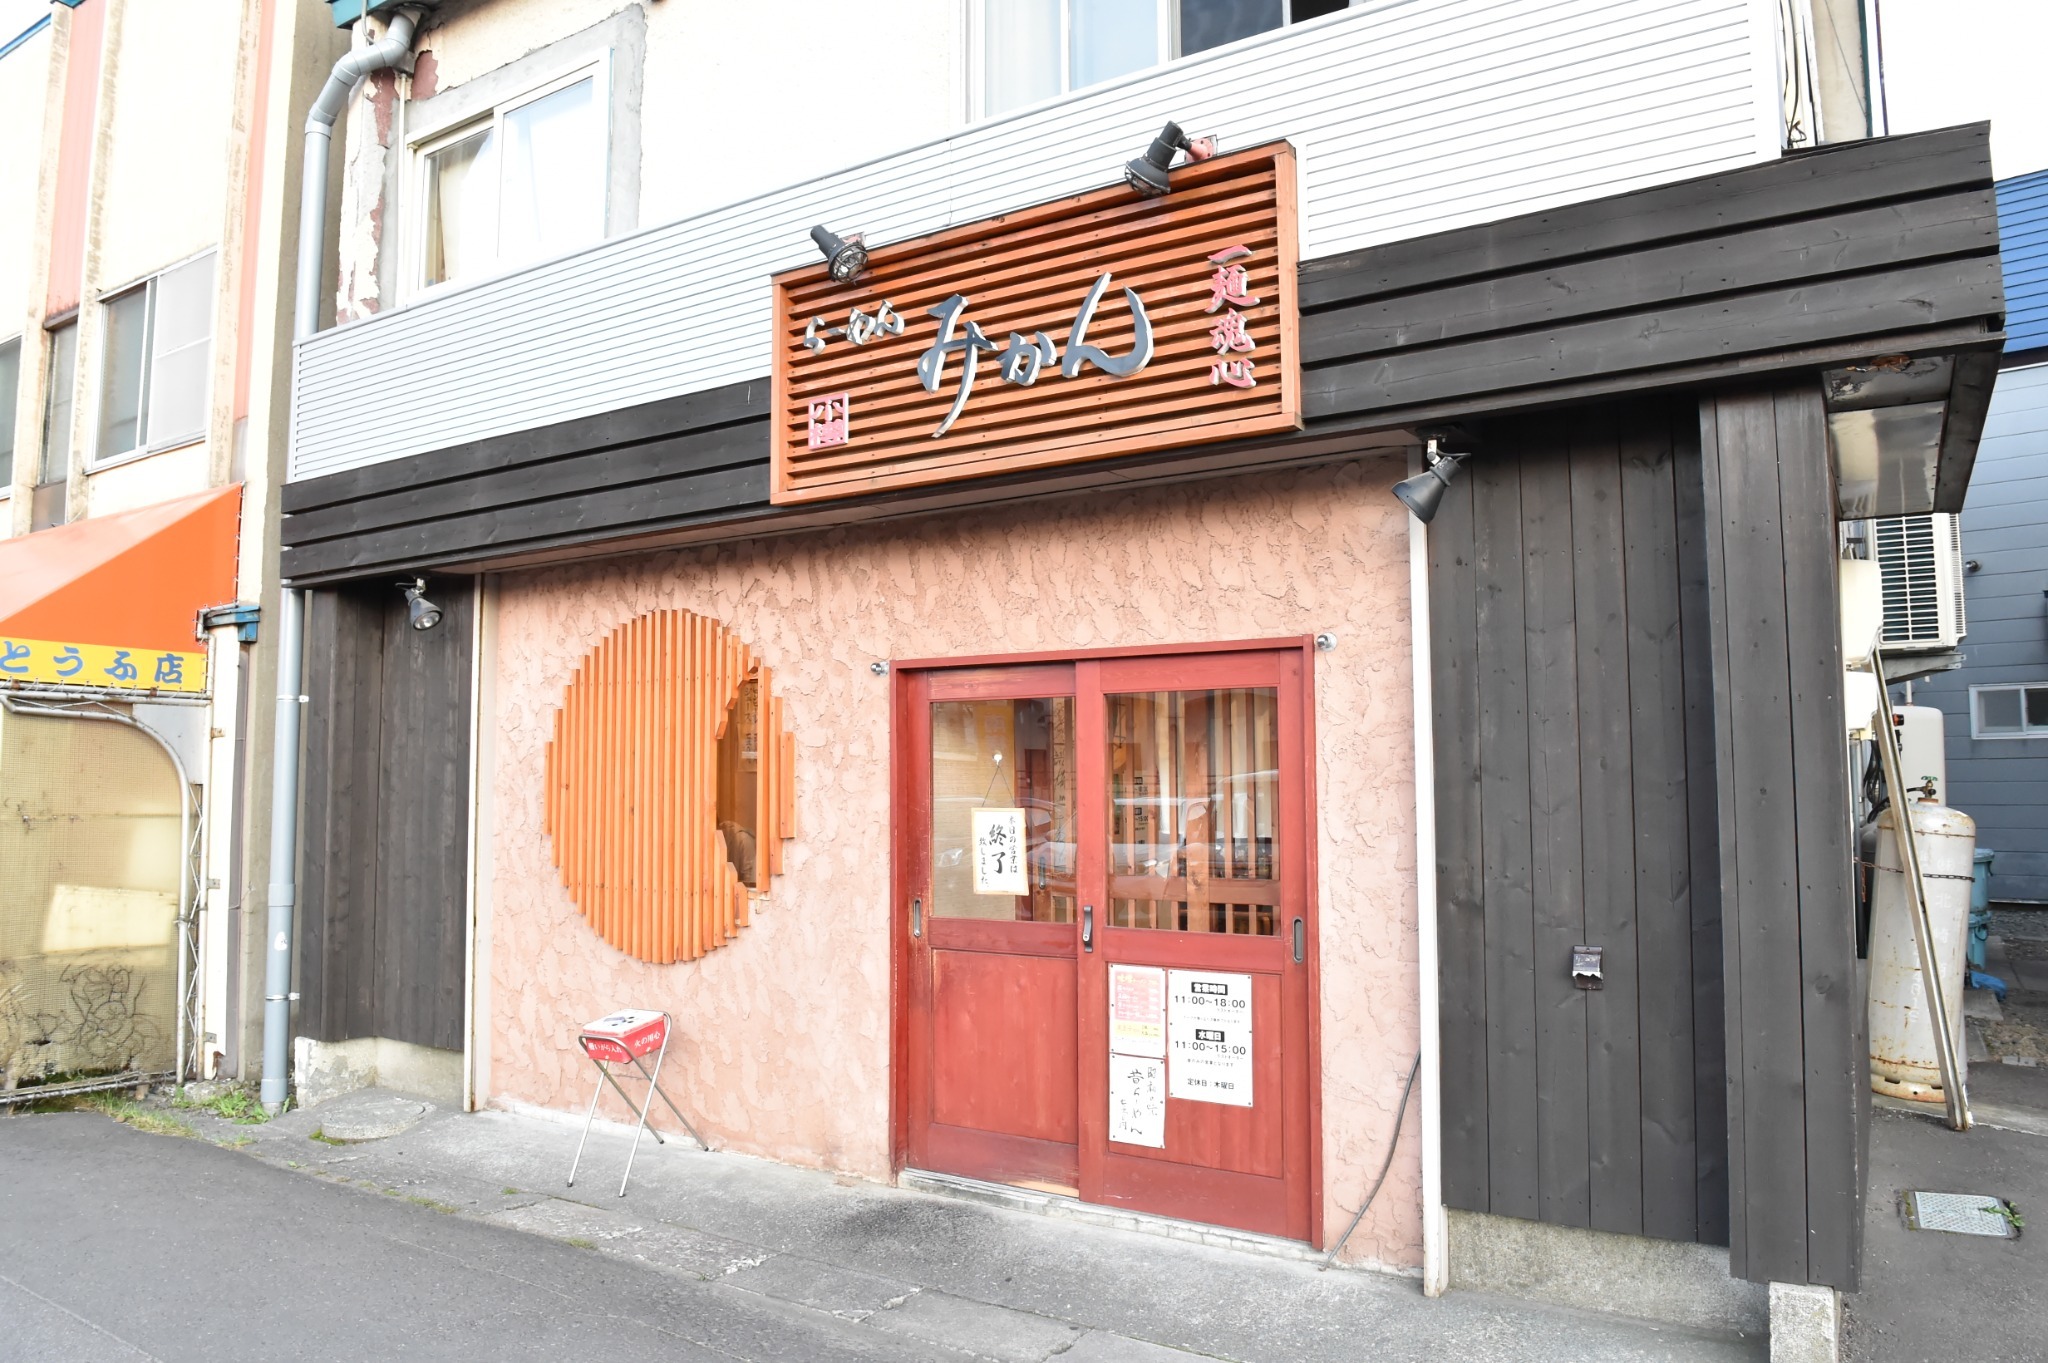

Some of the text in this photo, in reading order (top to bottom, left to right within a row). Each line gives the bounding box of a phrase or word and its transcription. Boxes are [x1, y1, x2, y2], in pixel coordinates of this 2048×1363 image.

[803, 299, 905, 356] らーめん
[1204, 245, 1261, 389] 一麺魂心
[917, 271, 1155, 439] みかん
[0, 640, 185, 685] とうふ店
[988, 824, 1007, 874] 終了
[1008, 815, 1018, 874] 本日の営業は
[1193, 983, 1226, 995] 営業時間
[634, 1031, 661, 1049] 火の用心
[1198, 1030, 1222, 1041] 水曜日
